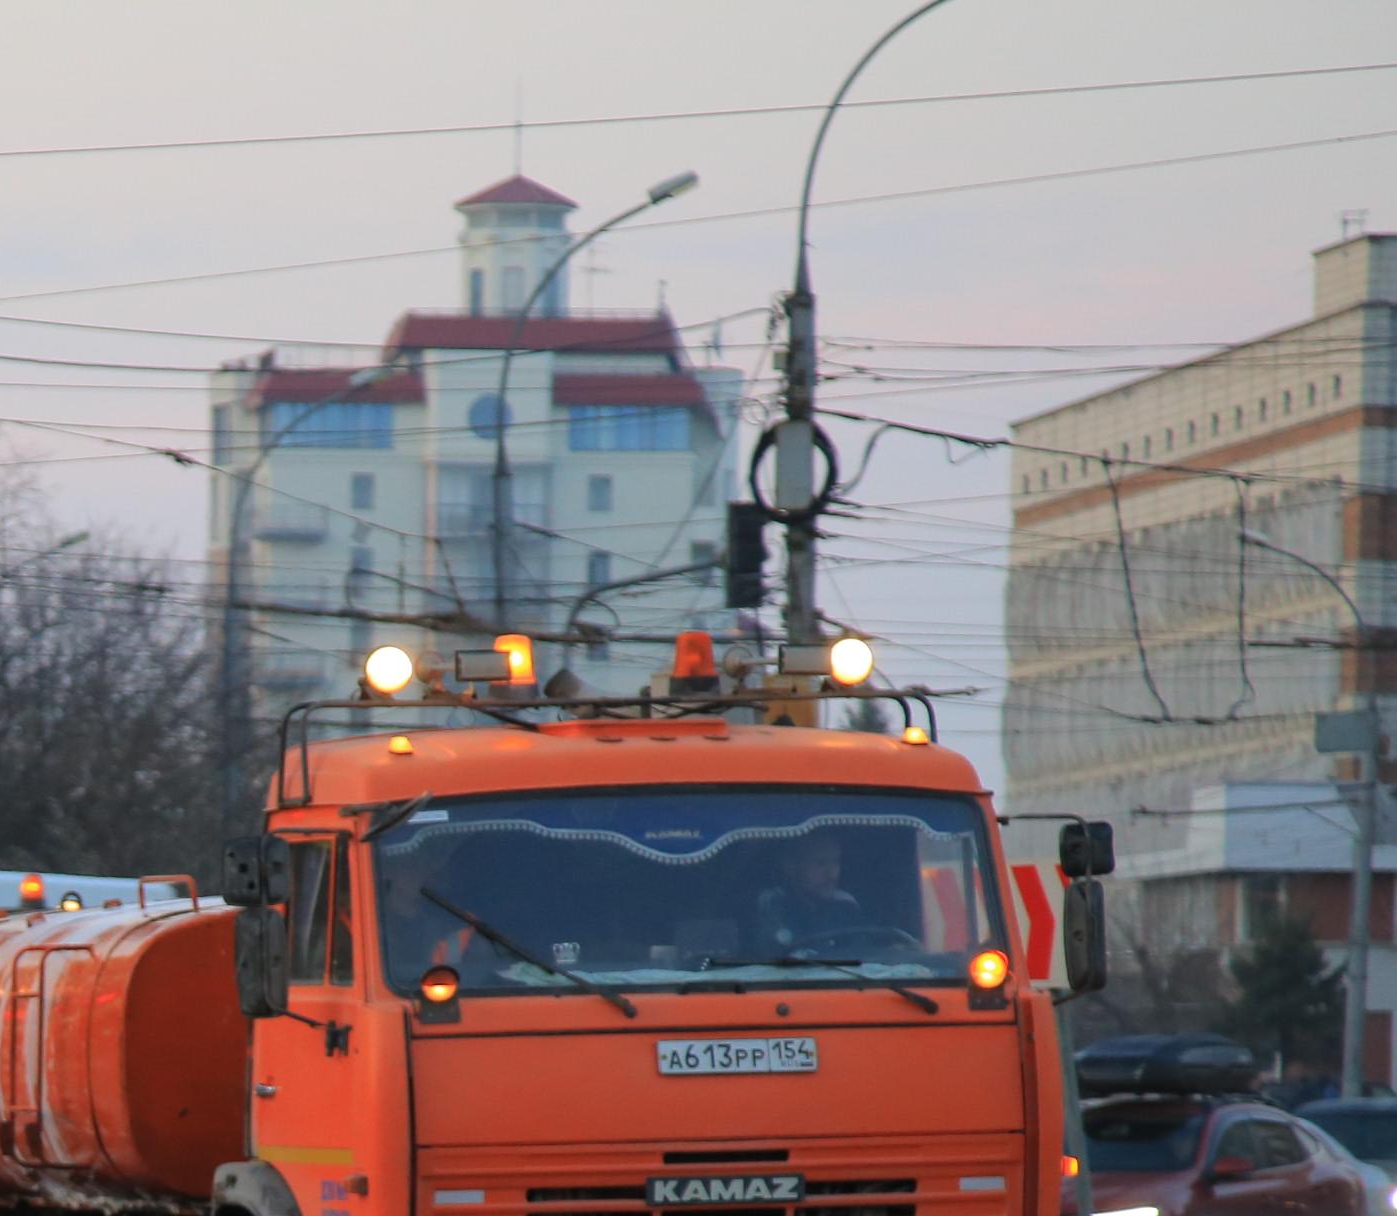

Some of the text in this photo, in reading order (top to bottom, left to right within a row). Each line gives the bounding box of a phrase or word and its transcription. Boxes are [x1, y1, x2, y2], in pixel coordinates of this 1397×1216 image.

[669, 1040, 811, 1069] А613РР 154
[654, 1176, 799, 1203] KAMAZ
